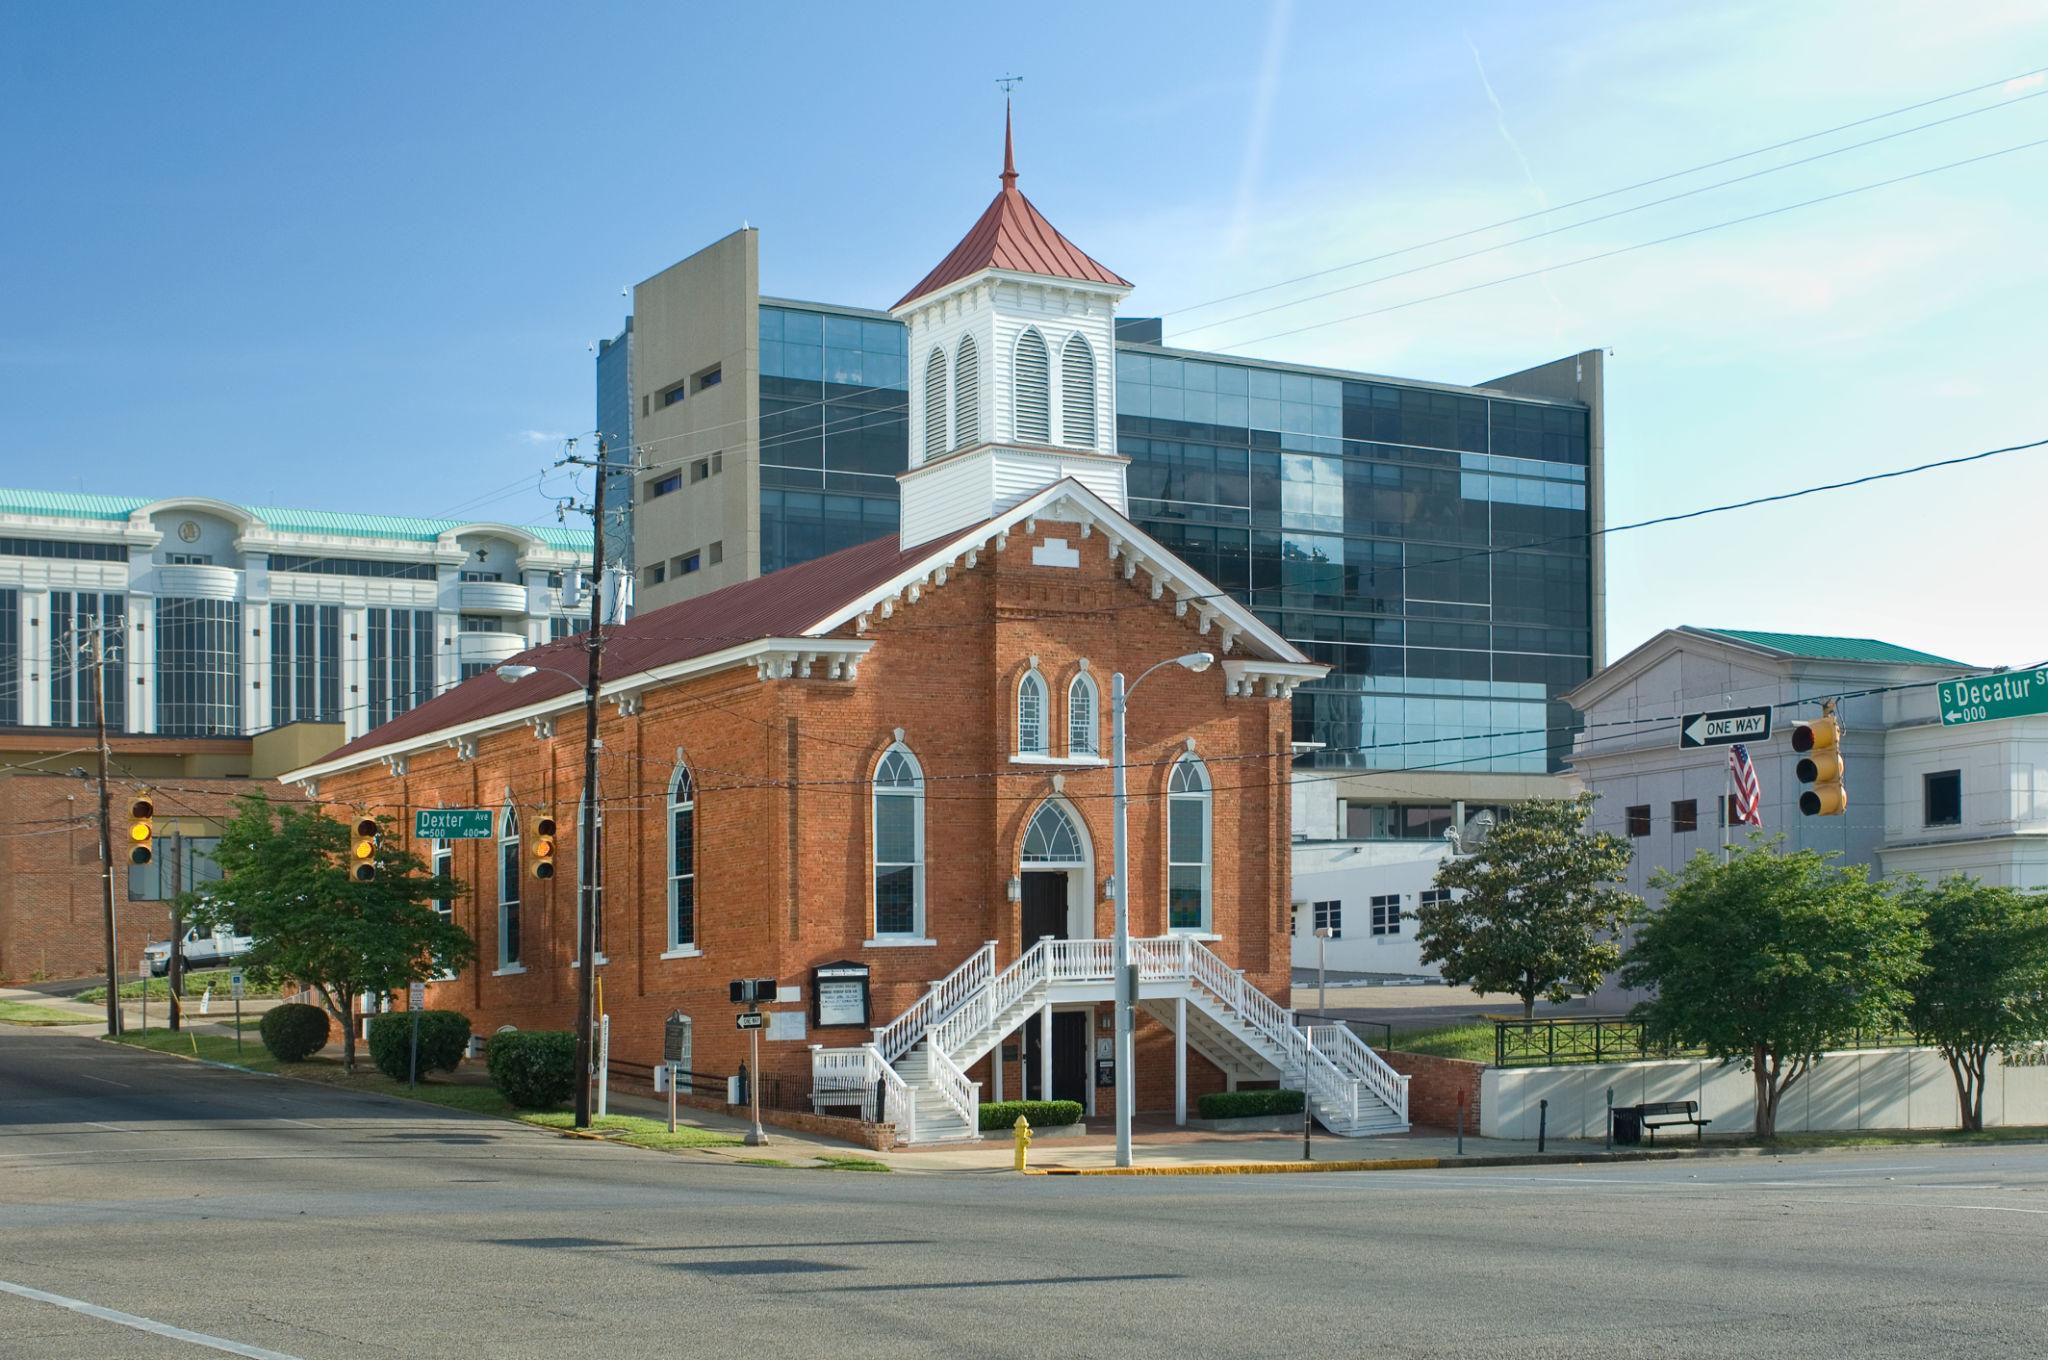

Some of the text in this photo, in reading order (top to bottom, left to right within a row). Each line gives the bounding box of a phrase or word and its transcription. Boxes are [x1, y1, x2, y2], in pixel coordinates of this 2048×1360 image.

[1943, 689, 1952, 703] S
[1956, 677, 2030, 706] Decatur
[1963, 706, 1986, 722] 000
[1707, 718, 1762, 736] ONE WAY
[421, 811, 489, 828] Dexter Ave
[429, 828, 479, 837] 500 400
[743, 1017, 752, 1025] ONE
